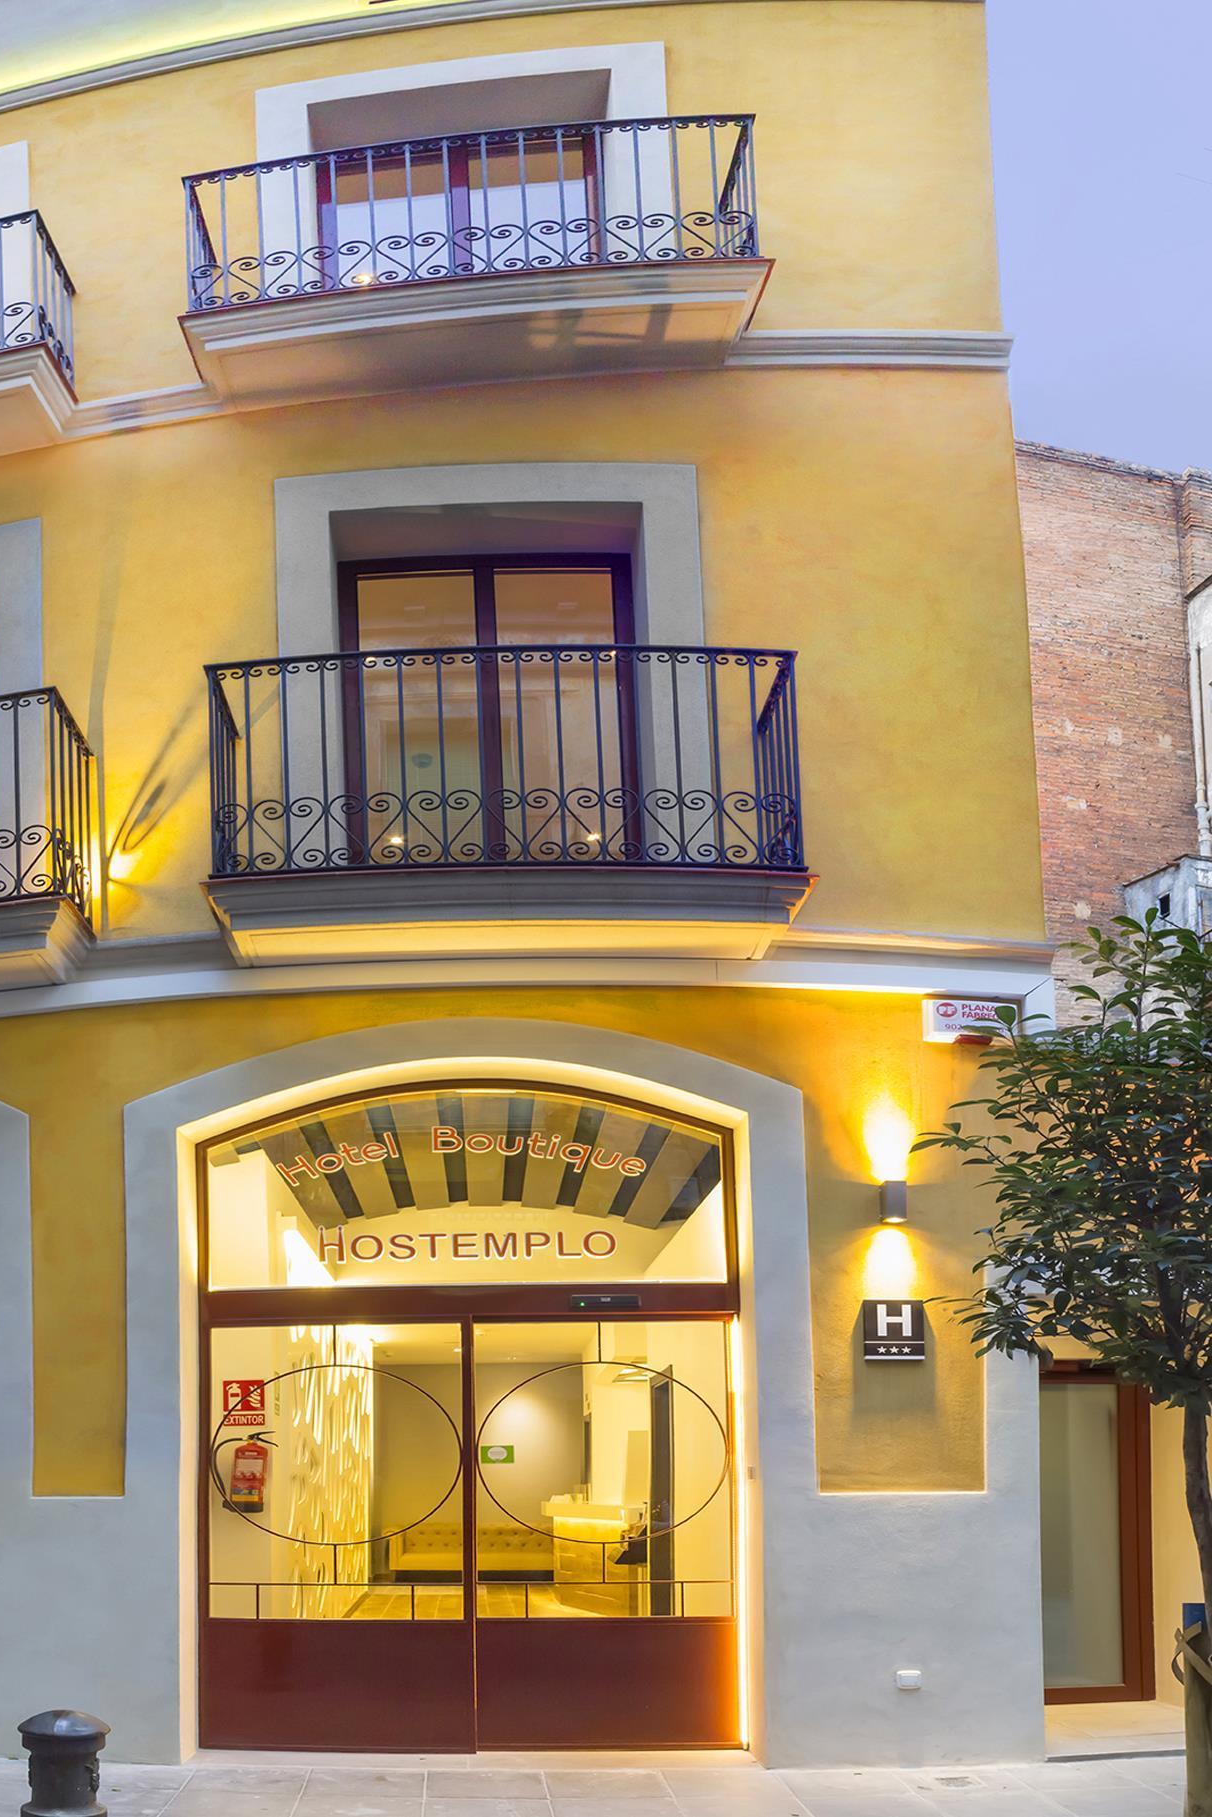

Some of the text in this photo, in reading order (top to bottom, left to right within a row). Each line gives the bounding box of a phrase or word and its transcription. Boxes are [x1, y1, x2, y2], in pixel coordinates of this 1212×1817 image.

[961, 1003, 997, 1012] PLANA
[275, 1125, 647, 1188] Hotel Boutique
[317, 1225, 618, 1265] HOSTEMPLO
[876, 1303, 912, 1337] H
[223, 1415, 264, 1425] EXTINTOR
